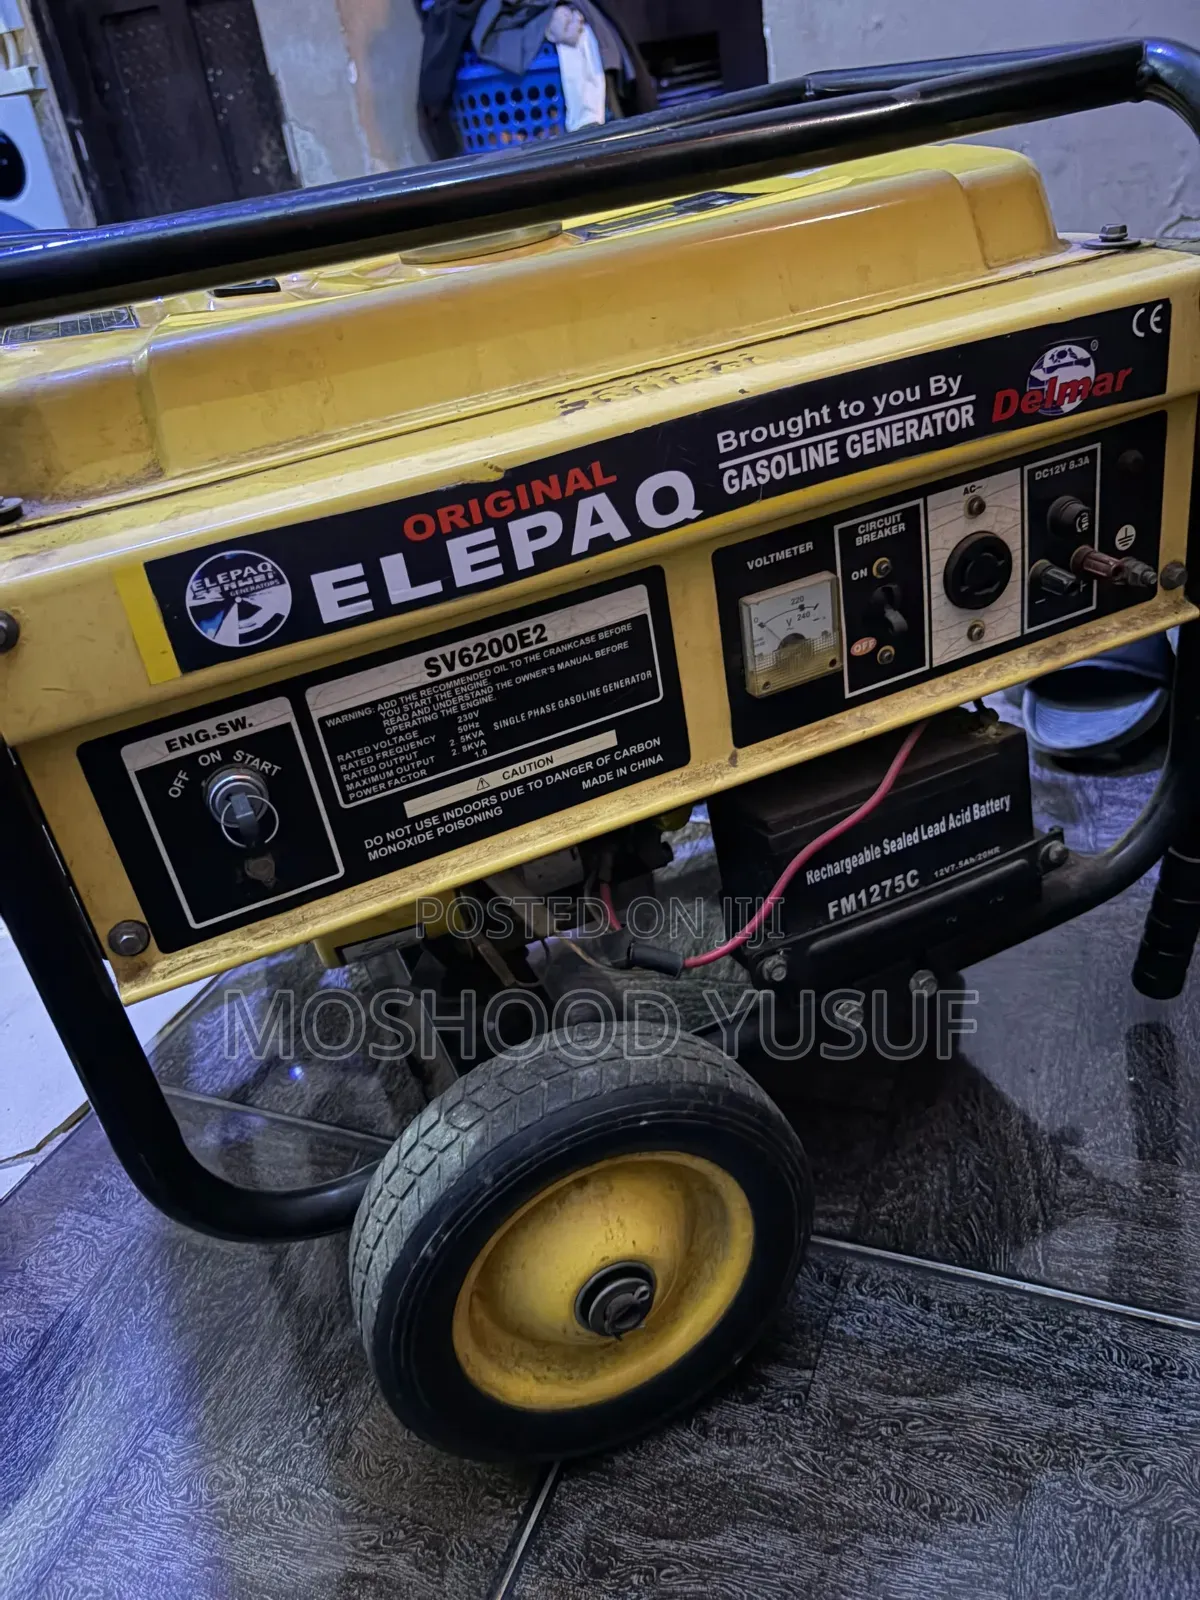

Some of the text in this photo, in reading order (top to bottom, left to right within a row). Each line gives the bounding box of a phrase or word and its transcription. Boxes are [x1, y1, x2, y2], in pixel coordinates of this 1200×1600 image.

[1132, 304, 1163, 337] CE
[716, 374, 963, 454] Brought to you By
[992, 367, 1133, 423] Delmar
[722, 404, 975, 495] GASOLINE GENERATOR
[1035, 455, 1090, 481] DC12V 8.3A
[403, 460, 617, 542] ORIGINAL
[855, 523, 905, 546] BREAKER
[858, 513, 903, 534] CIRCUIT
[310, 470, 704, 624] ELEPAQ
[746, 541, 814, 570] VOLTMETER
[192, 562, 274, 591] ELEPAQ
[851, 568, 868, 581] ON
[790, 595, 805, 606] 220
[797, 611, 811, 621] 240
[424, 623, 548, 678] SV6200E2
[853, 639, 875, 653] OFF
[325, 623, 632, 728] WARNING: ADD THE RECOMMENDED OIL TO THE CRANKCASE BEFORE
[383, 641, 629, 727] READ AND UNDERSTAND THE OWNER'S MANUAL BEFORE
[380, 708, 400, 719] YOU
[403, 697, 432, 712] START
[434, 690, 452, 702] THE
[385, 713, 438, 735] OPERATING
[440, 706, 458, 717] THE
[493, 670, 653, 731] SINGLE PHASE GASOLINE GENERATOR
[165, 716, 254, 753] ENG.SW.
[337, 710, 479, 762] RATED VOLTAGE 230V
[340, 722, 480, 772] RATED FREQUENCY 50Hz
[168, 750, 282, 798] OFF ON START
[343, 765, 377, 781] RATED
[379, 751, 418, 770] OUTPUT
[346, 770, 394, 791] MAXIMUM
[396, 756, 435, 774] OUTPUT
[349, 749, 488, 800] POWER FACTOR 1.0
[502, 755, 554, 781] CAUTION
[581, 754, 664, 790] MADE IN CHINA
[364, 737, 661, 849] DO NOT USE INDOORS DUE TO DANGER OF CARBON
[368, 806, 503, 862] MONOXIDE POISONING
[806, 795, 1010, 885] Rechargeable Sealed Lead Acid Battery
[827, 869, 920, 921] FM1275C
